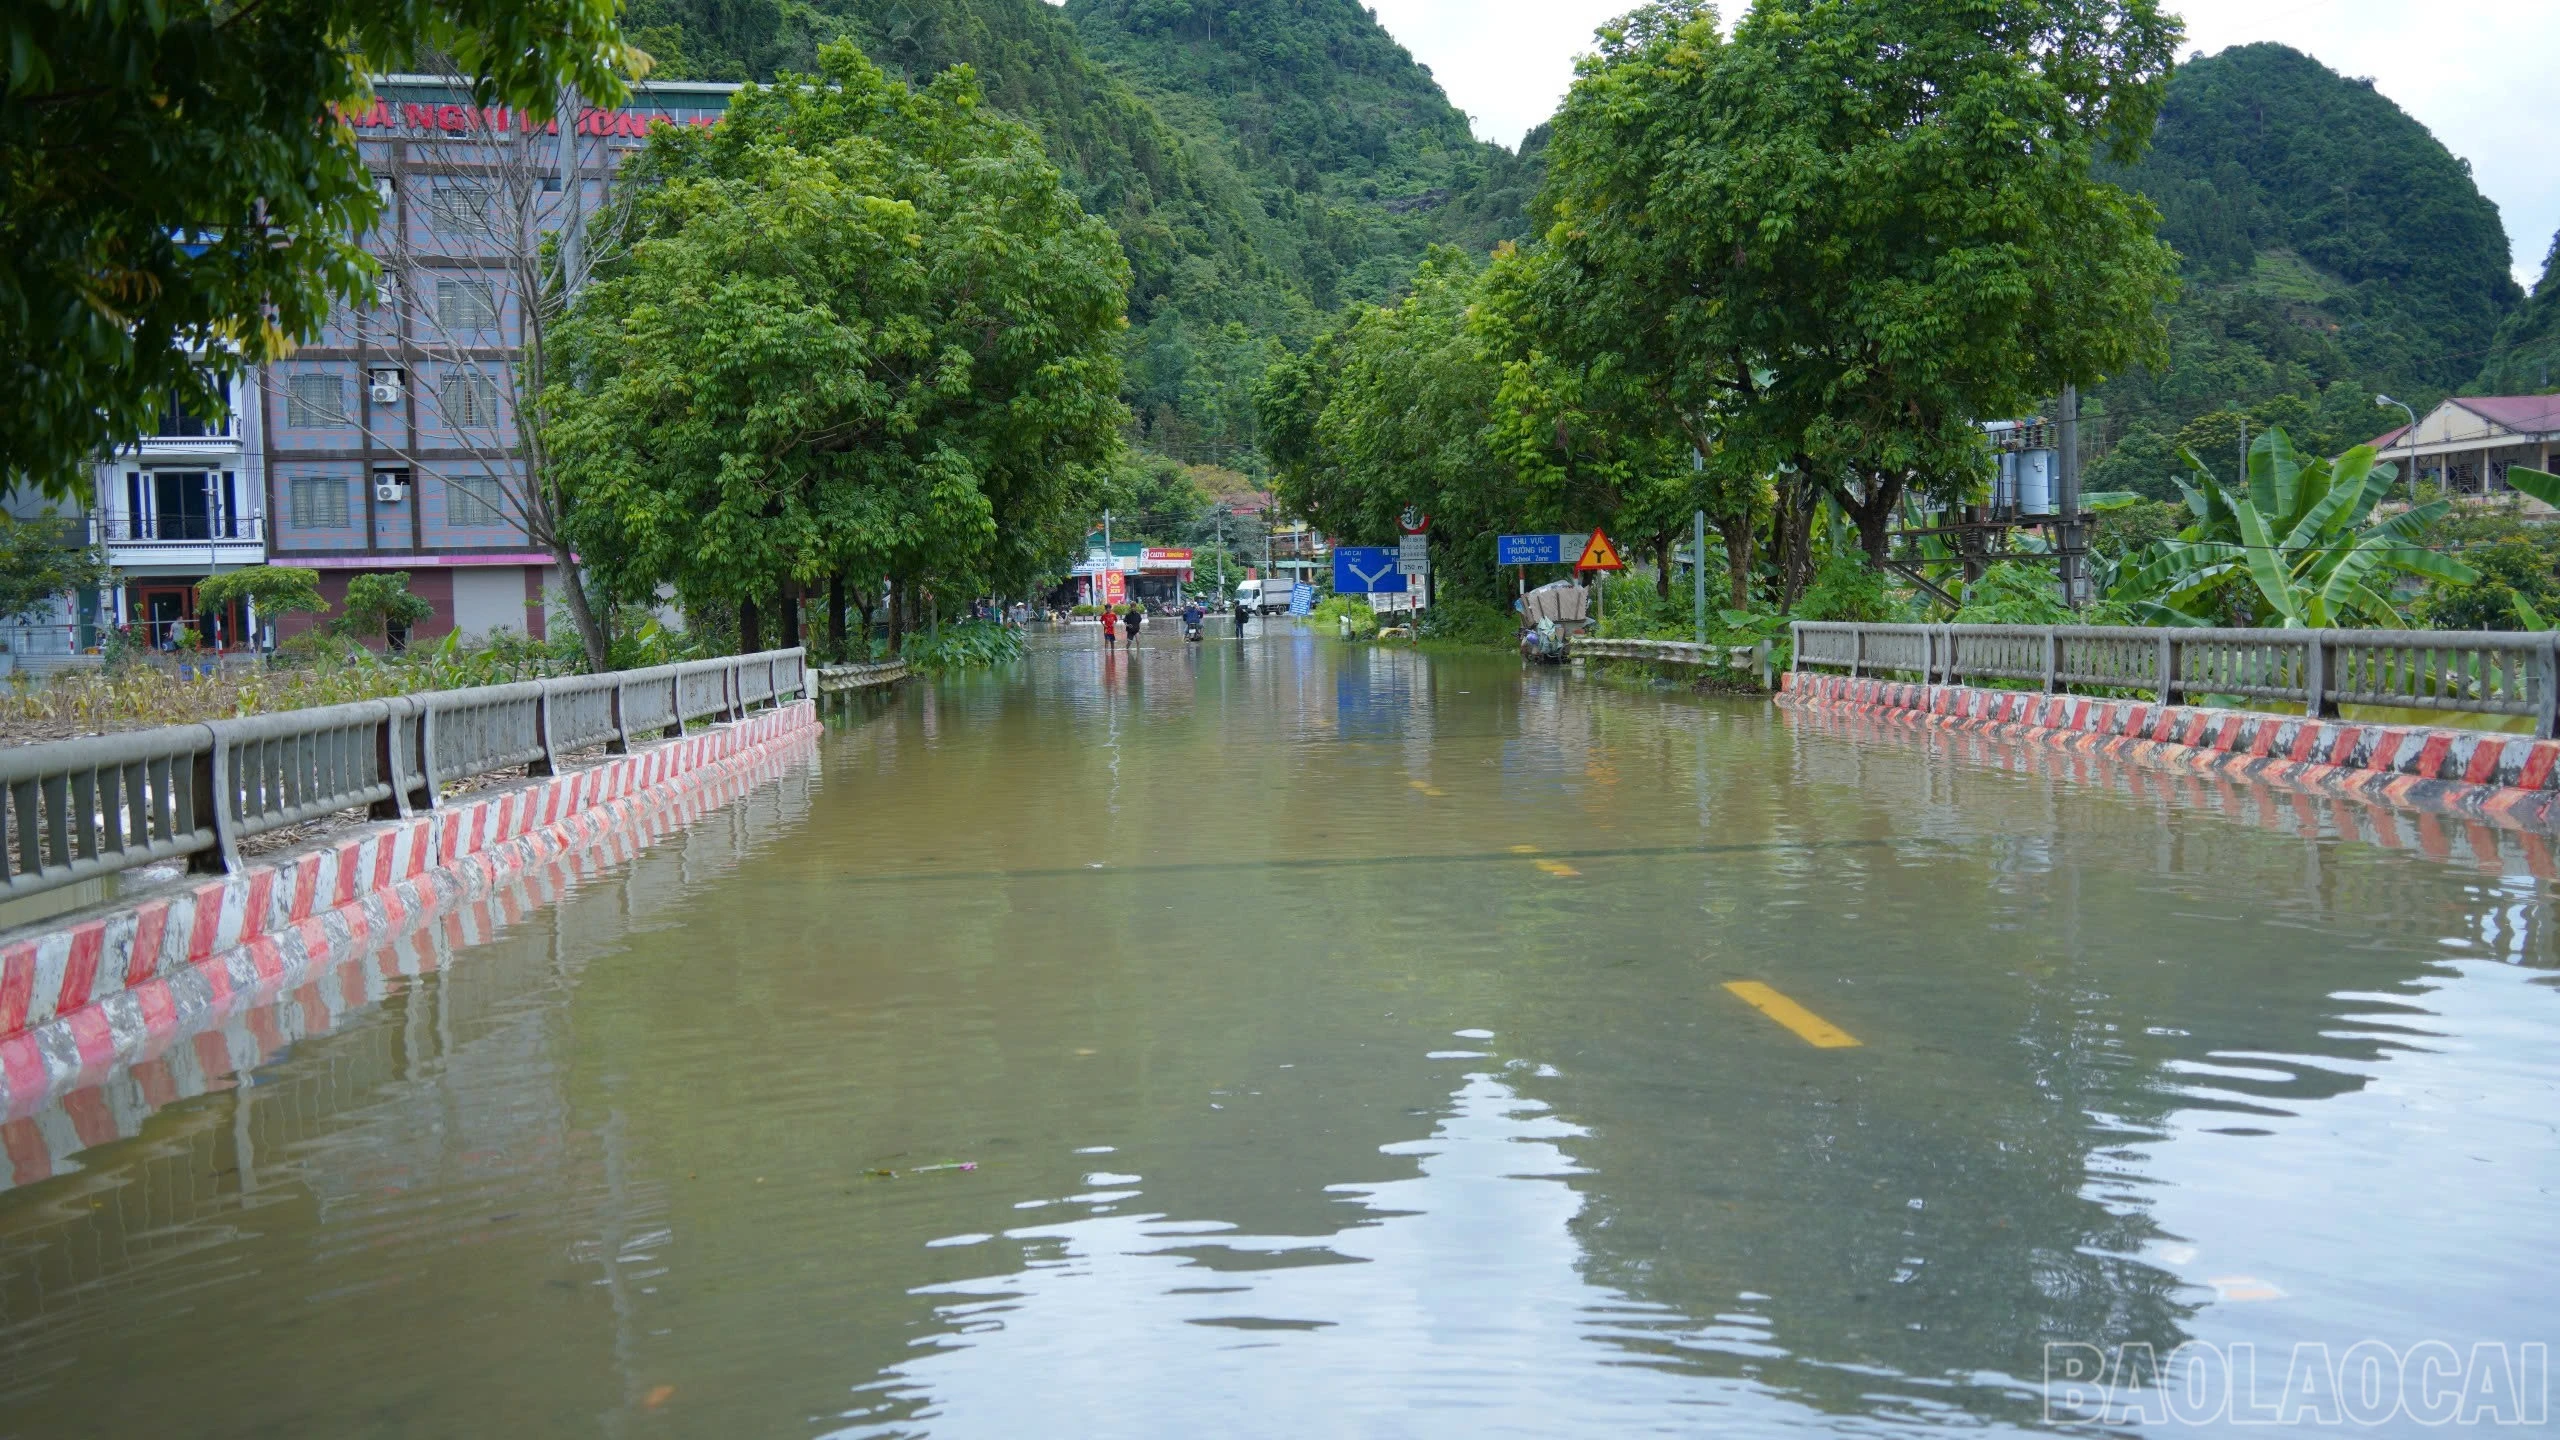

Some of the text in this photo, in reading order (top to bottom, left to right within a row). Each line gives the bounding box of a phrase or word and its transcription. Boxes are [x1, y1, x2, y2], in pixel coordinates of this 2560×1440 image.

[1512, 536, 1545, 545] KHU VỰC
[1506, 546, 1553, 554] TRƯỜNG HỌC
[1535, 554, 1549, 562] Zone
